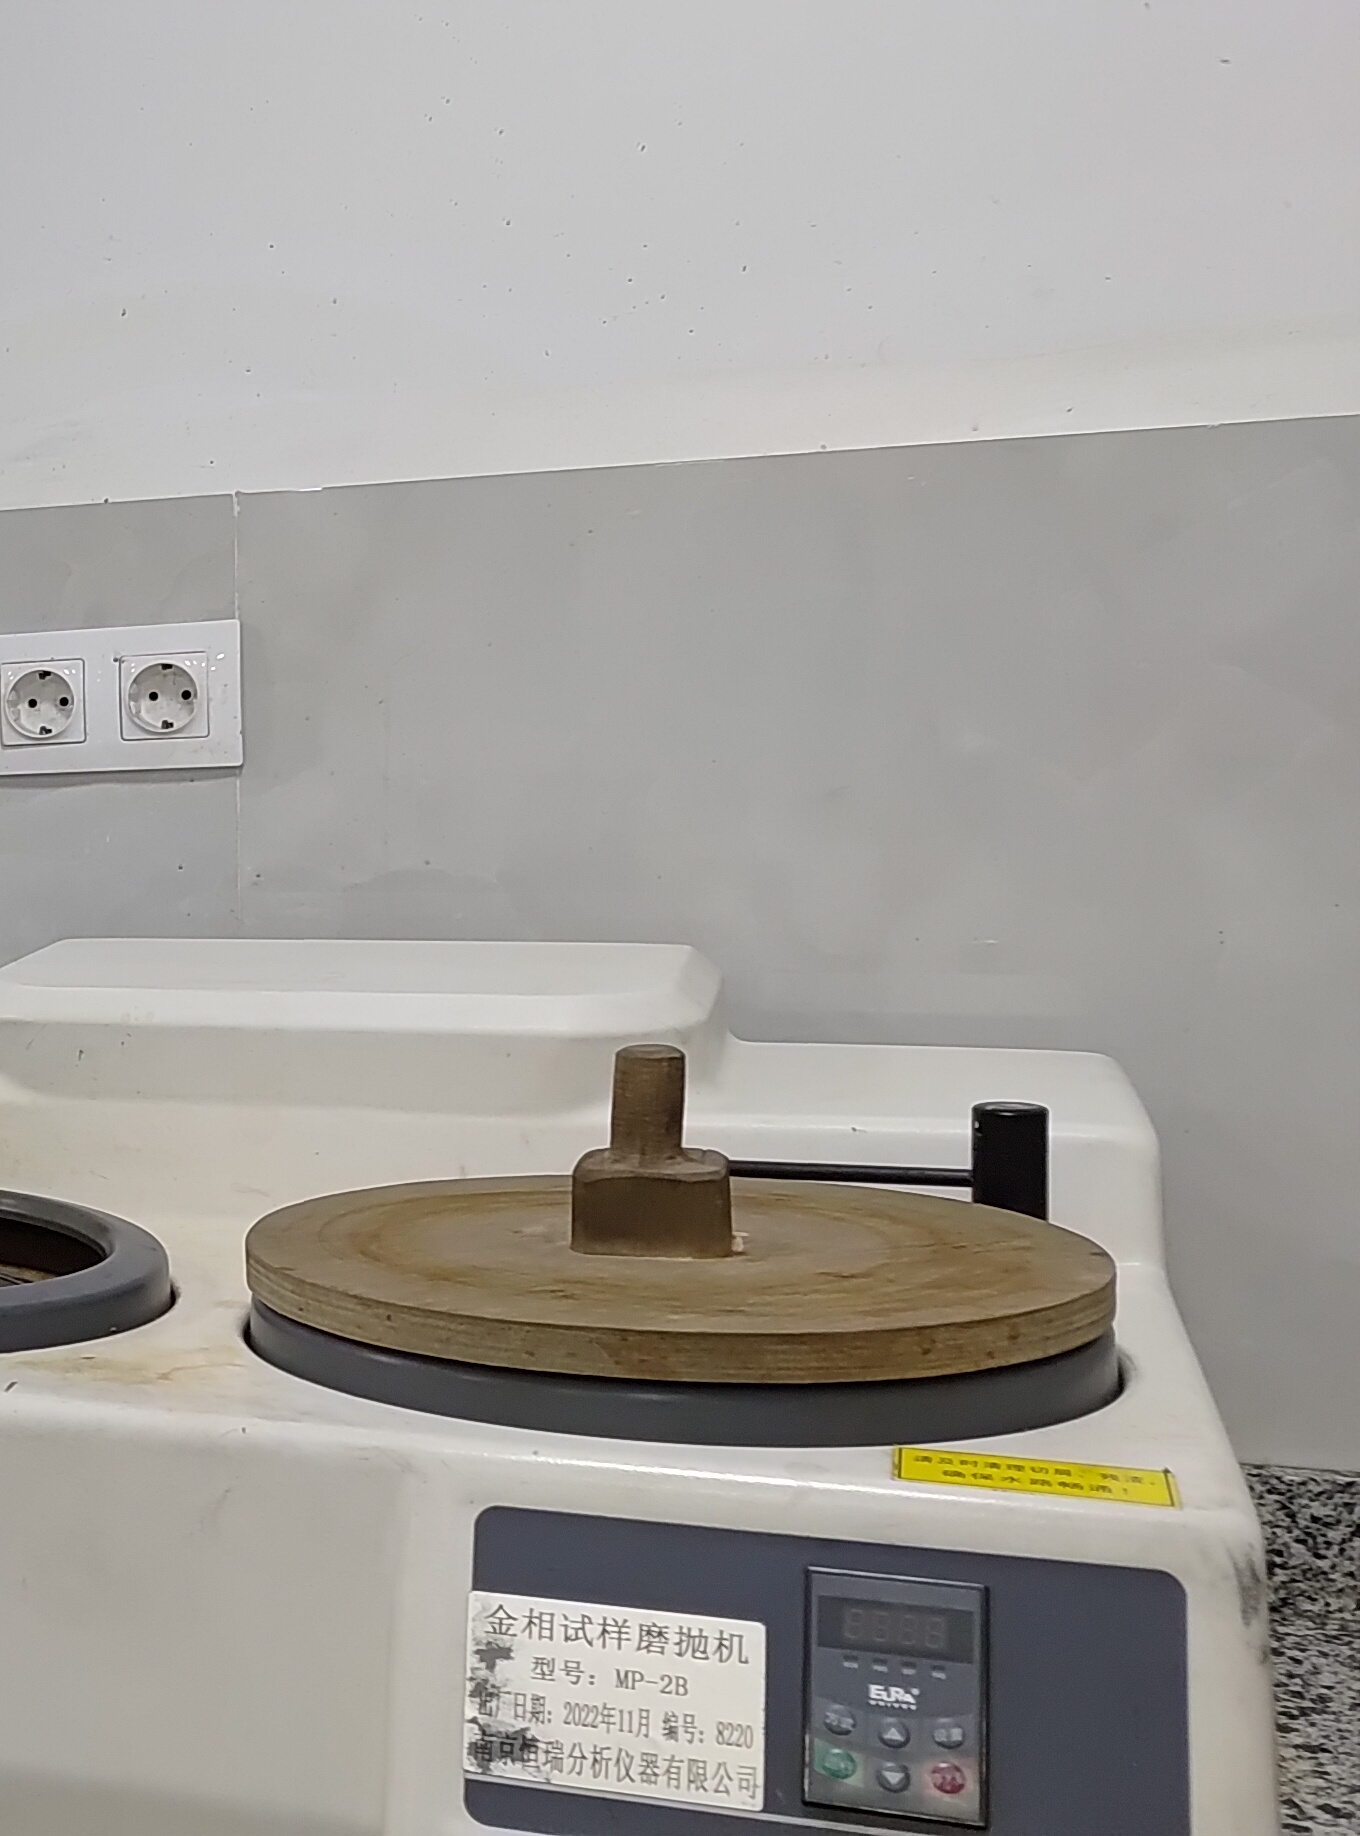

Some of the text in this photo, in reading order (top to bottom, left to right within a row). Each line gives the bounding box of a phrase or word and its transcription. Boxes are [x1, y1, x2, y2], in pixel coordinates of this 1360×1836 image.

[483, 1603, 750, 1665] 金相试样磨抛机
[615, 1668, 689, 1697] MP-2B
[716, 1722, 754, 1750] 8220
